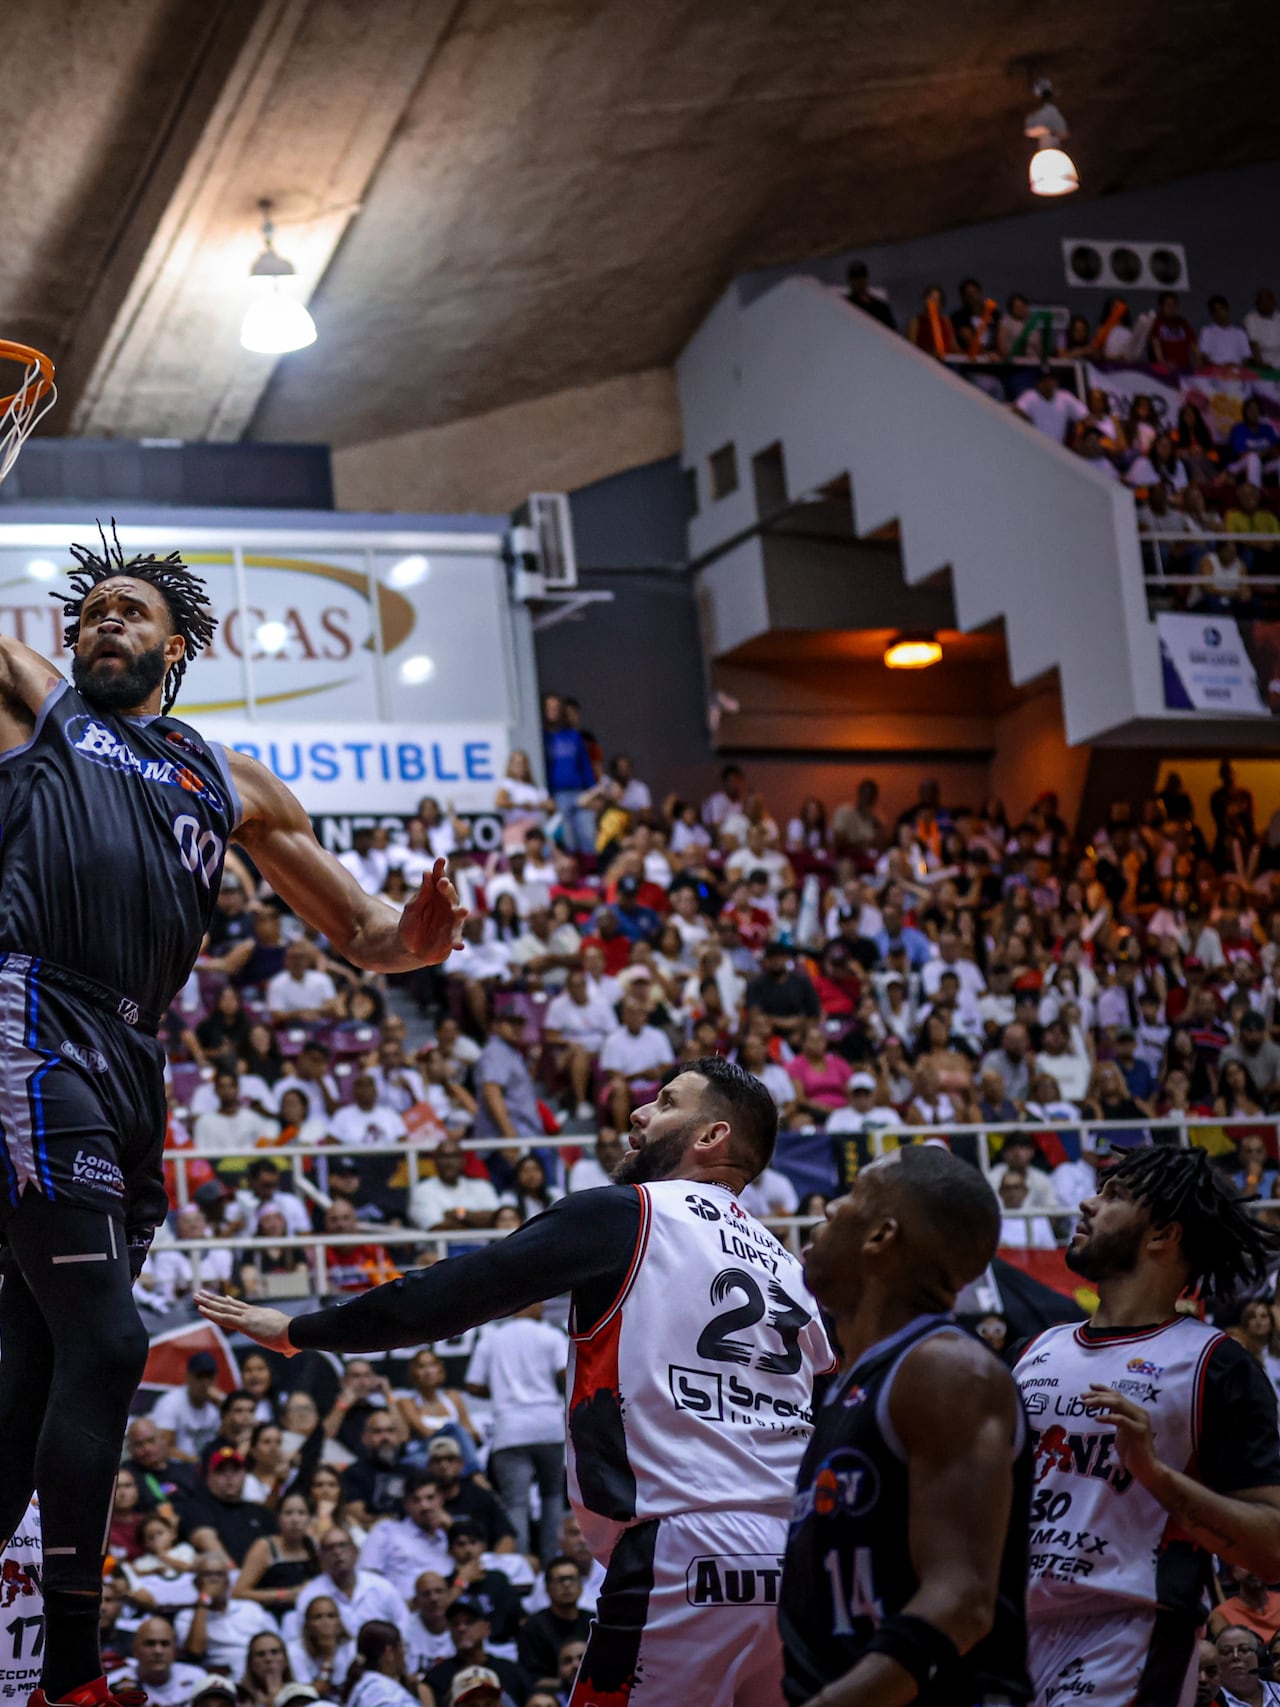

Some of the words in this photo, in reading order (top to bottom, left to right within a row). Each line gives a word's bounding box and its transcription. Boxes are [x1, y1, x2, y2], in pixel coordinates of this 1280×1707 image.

[231, 742, 496, 782] USTIBLE
[723, 1212, 751, 1238] SAN
[719, 1228, 782, 1284] LOPEZ
[1030, 1488, 1072, 1524] 30
[823, 1546, 885, 1637] 14
[6, 1614, 45, 1660] 17
